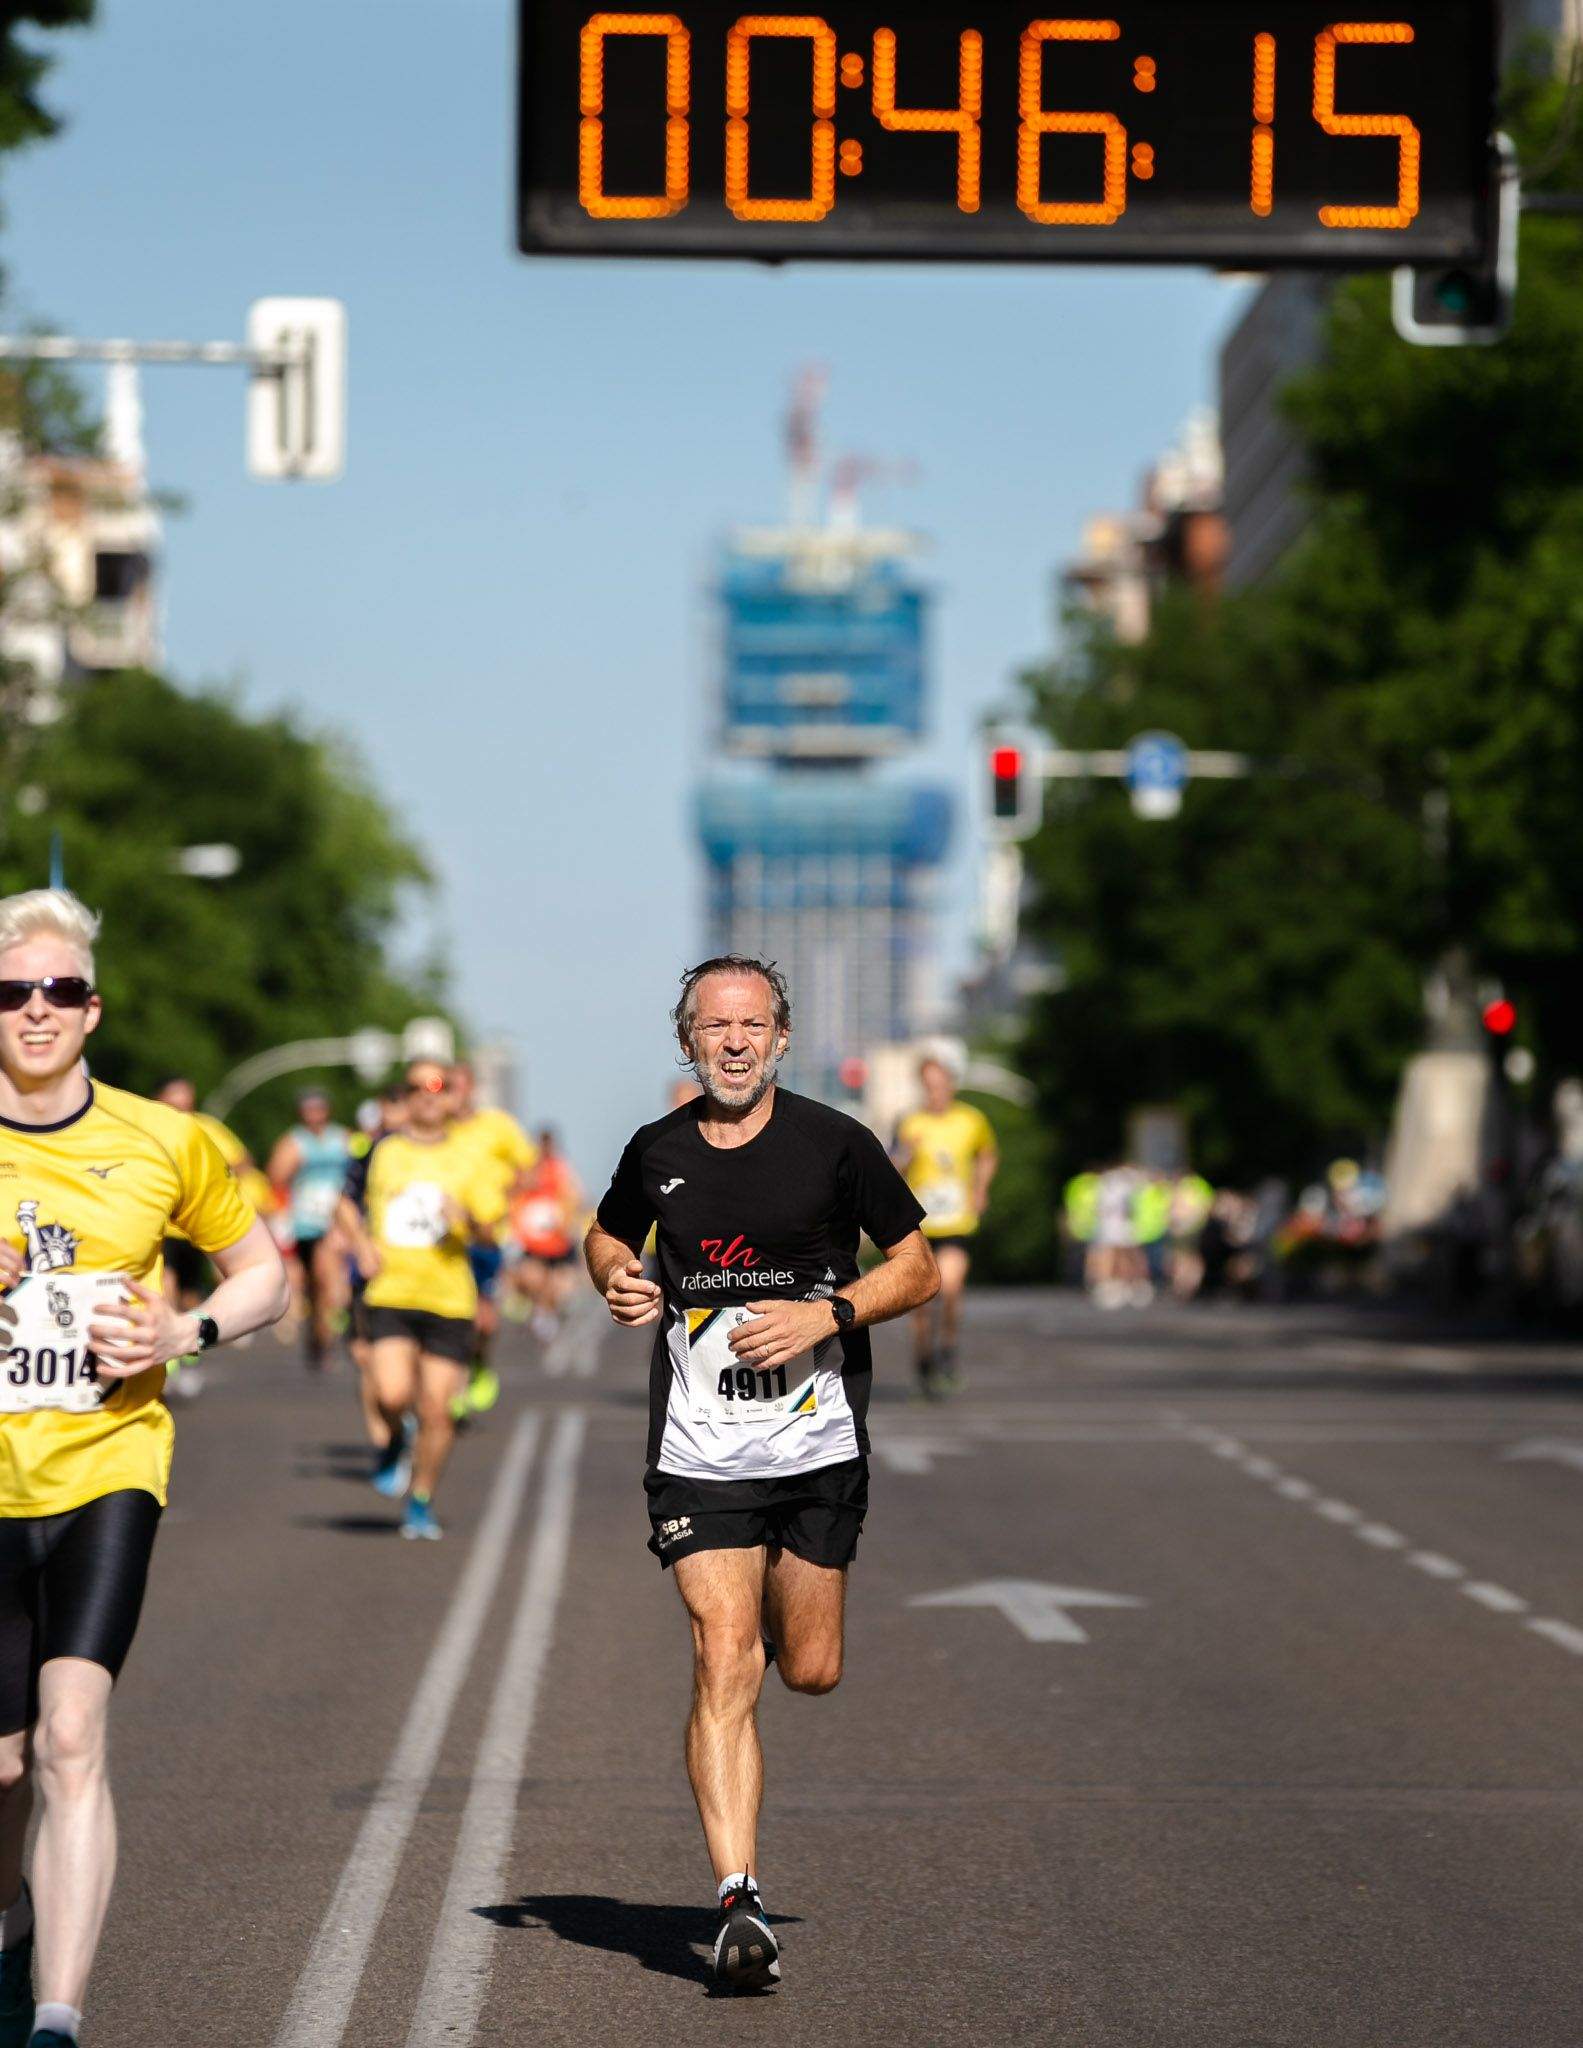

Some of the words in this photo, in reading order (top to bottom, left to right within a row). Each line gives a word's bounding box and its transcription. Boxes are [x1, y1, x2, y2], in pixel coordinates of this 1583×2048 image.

[579, 13, 1421, 229] 00:46:15
[681, 1268, 795, 1290] rafaelhoteles
[8, 1347, 99, 1385] 3014
[718, 1364, 787, 1401] 4911
